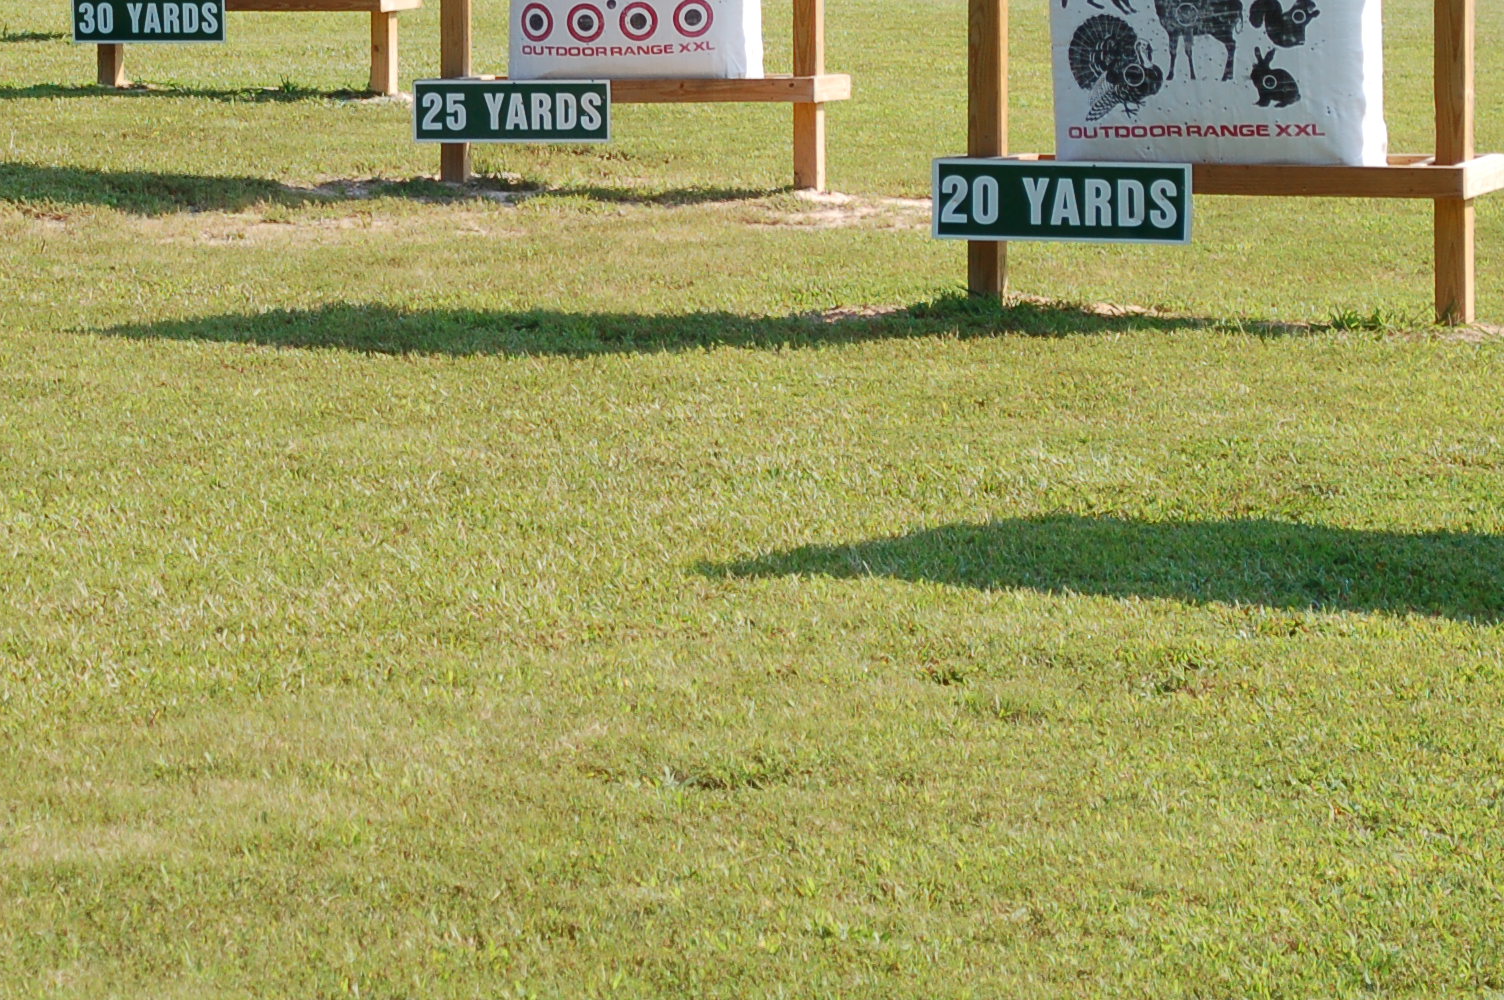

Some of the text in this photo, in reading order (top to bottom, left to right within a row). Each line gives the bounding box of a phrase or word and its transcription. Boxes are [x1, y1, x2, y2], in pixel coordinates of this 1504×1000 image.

[78, 1, 219, 34] 30 YARDS
[522, 41, 715, 56] OUTDOOR RANGE XXL
[421, 92, 603, 131] 25 YARDS
[1068, 124, 1325, 138] OUTDOOR RANGE XXL
[940, 174, 1178, 228] 20 YARDS
